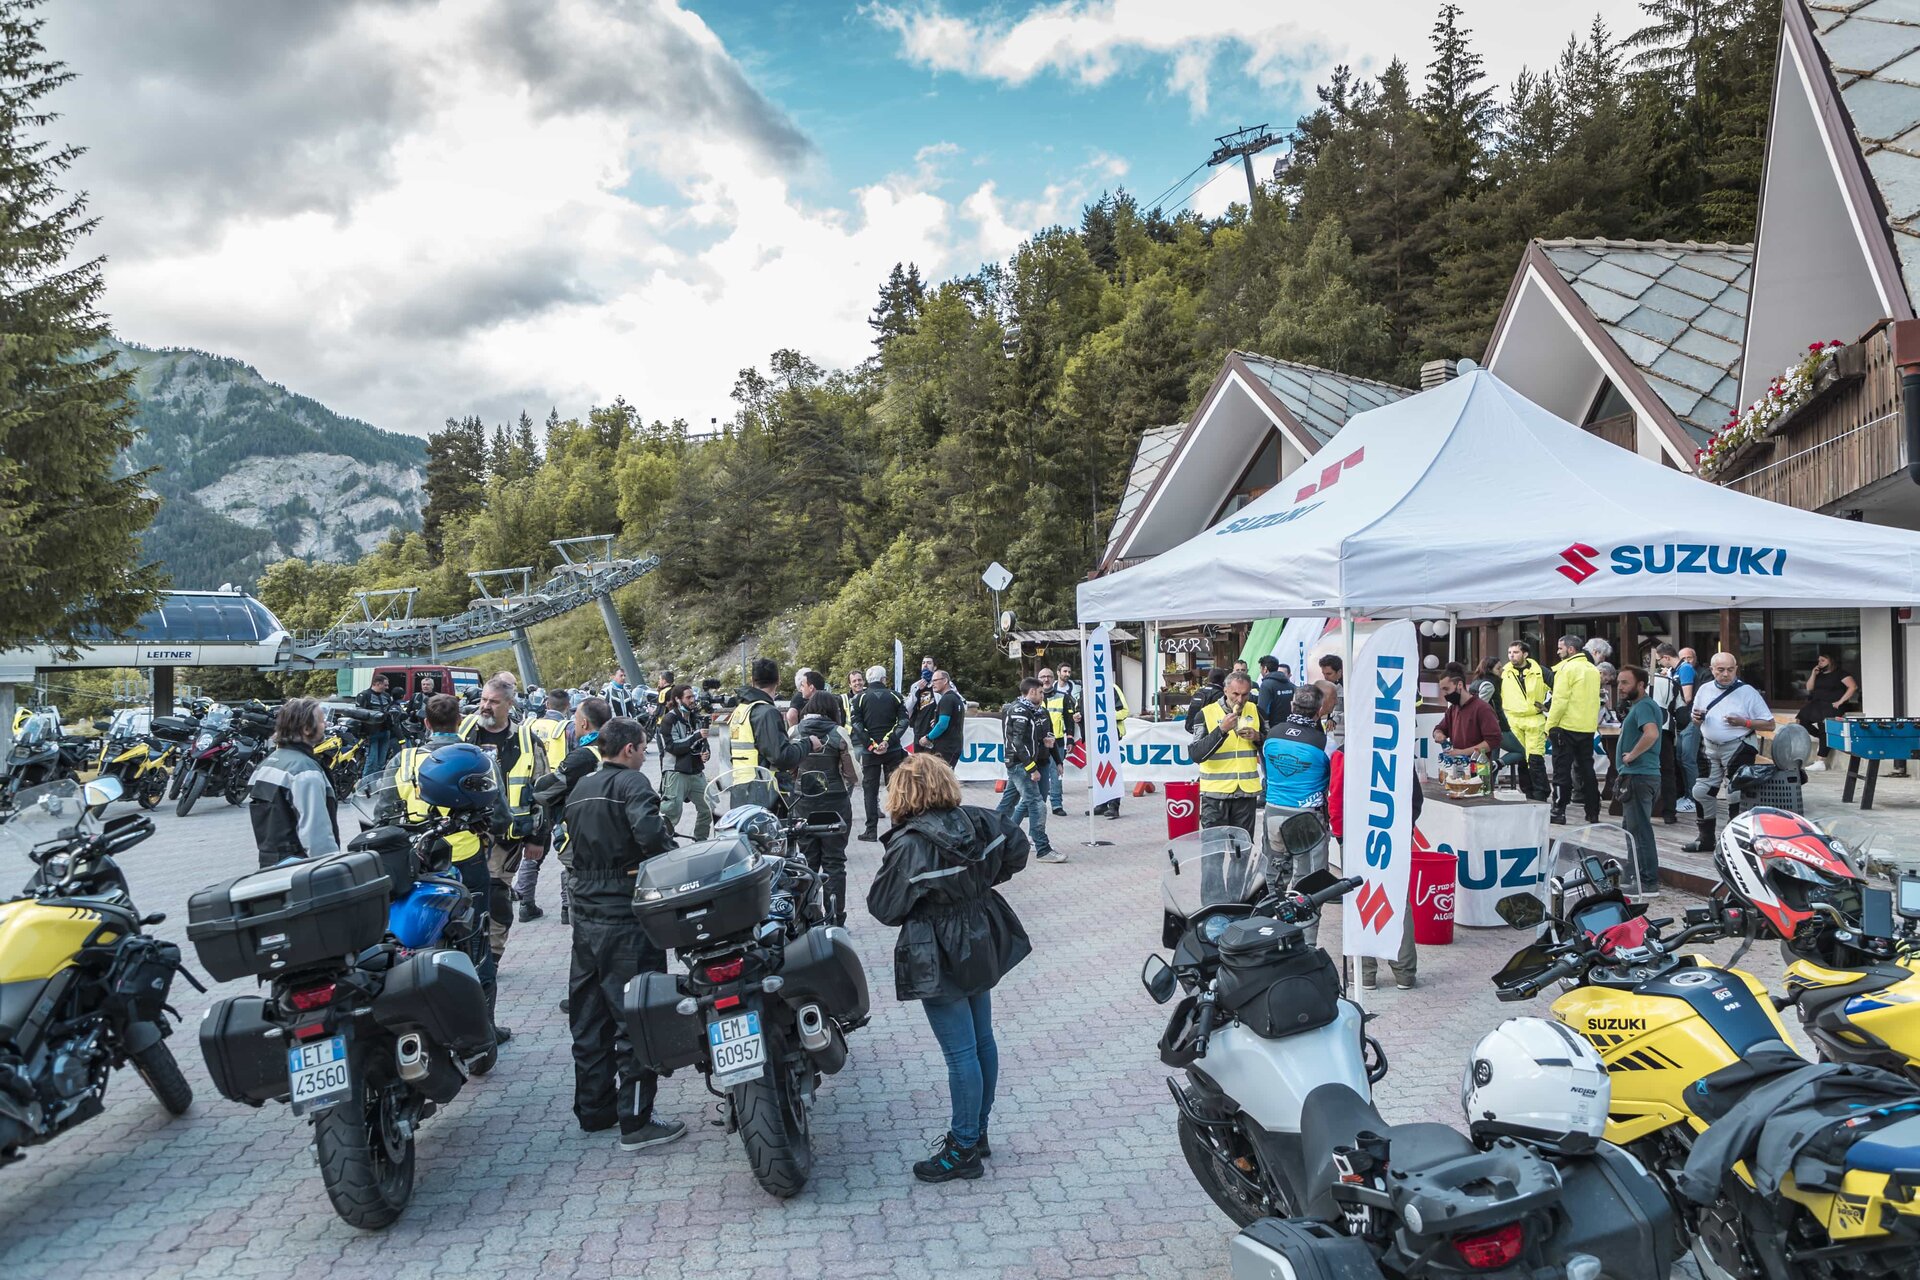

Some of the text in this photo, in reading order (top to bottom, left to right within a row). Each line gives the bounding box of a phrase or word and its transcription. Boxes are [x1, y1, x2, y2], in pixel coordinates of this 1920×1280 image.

[1215, 501, 1327, 535] SUZUKI
[1610, 544, 1787, 576] SUZUKI
[147, 651, 193, 659] LEITNER
[1165, 637, 1202, 654] BAR
[1093, 643, 1111, 755] SUZUKI
[1119, 744, 1195, 766] UZU
[1365, 655, 1405, 870] SUZUKI
[1437, 842, 1545, 890] UZ
[1775, 843, 1826, 867] SUZUKI
[679, 880, 700, 892] GIVI
[1433, 913, 1454, 921] ALGID
[721, 1019, 742, 1041] EM
[1587, 1018, 1646, 1030] SUZUKI
[302, 1044, 322, 1067] ET
[716, 1040, 760, 1068] 60957
[296, 1064, 346, 1096] 43560
[1570, 1086, 1597, 1096] NOLAN
